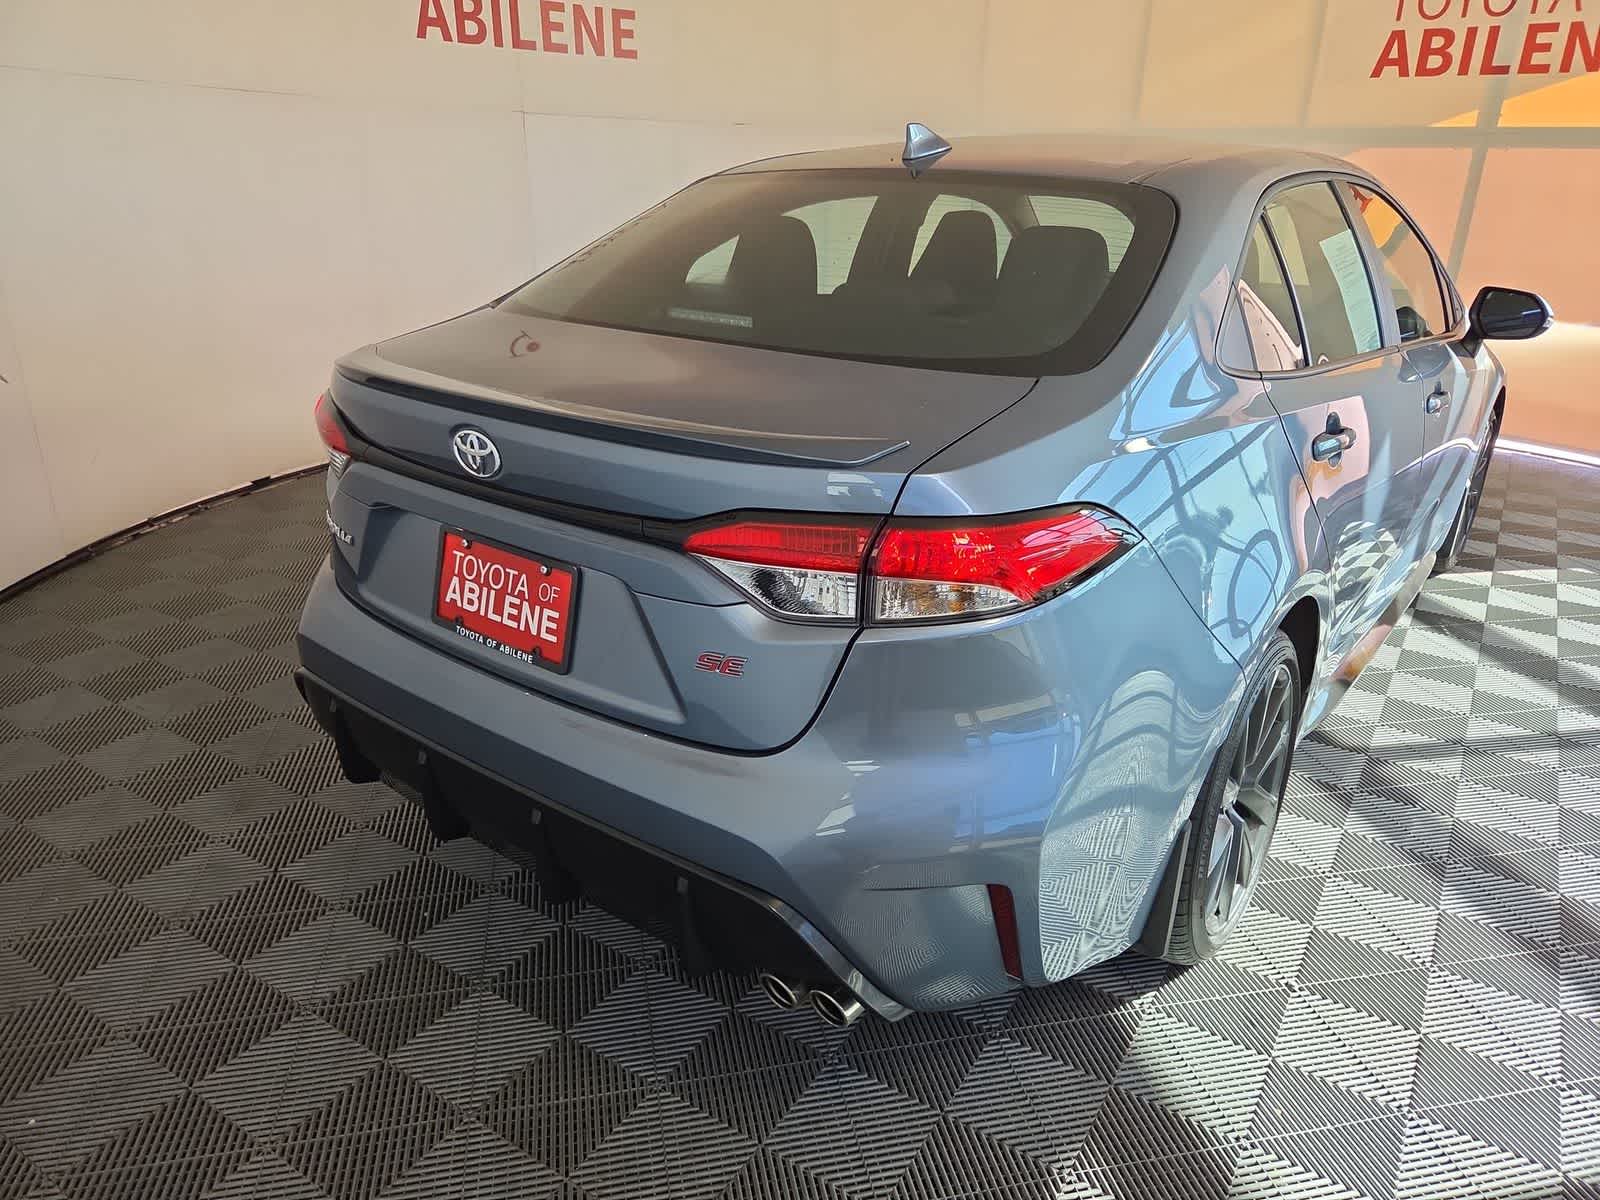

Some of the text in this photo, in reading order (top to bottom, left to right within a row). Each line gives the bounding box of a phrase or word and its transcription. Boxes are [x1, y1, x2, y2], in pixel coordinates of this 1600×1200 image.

[416, 0, 638, 60] ABILENE
[452, 550, 561, 603] TOYOTA OF
[445, 575, 560, 643] ABILENE
[456, 625, 533, 664] TOYOTA OF ABILENE
[695, 650, 748, 678] SE
